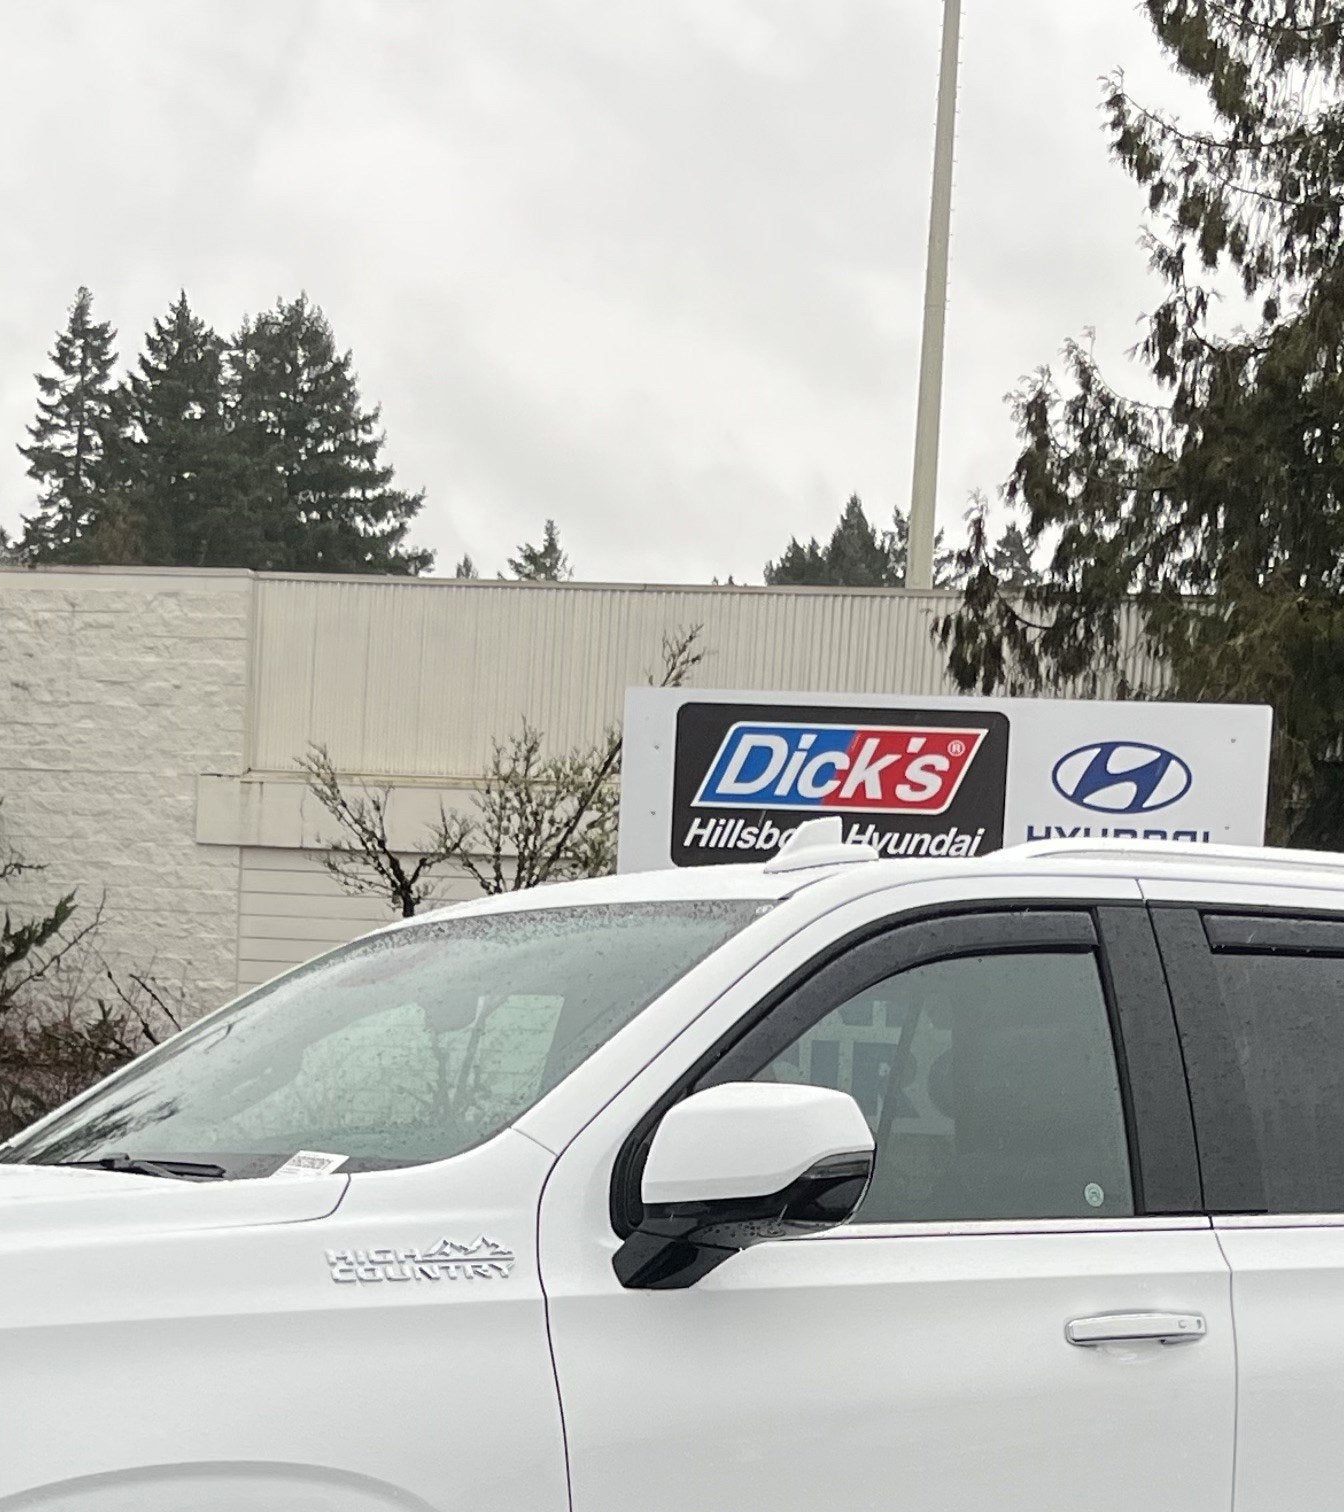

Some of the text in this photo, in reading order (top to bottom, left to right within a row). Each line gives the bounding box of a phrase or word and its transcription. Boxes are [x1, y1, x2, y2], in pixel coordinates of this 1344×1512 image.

[715, 734, 950, 803] Dick's
[683, 817, 798, 851] Hillsbo
[325, 1247, 423, 1266] HIGH
[331, 1263, 514, 1283] COUNTRY
